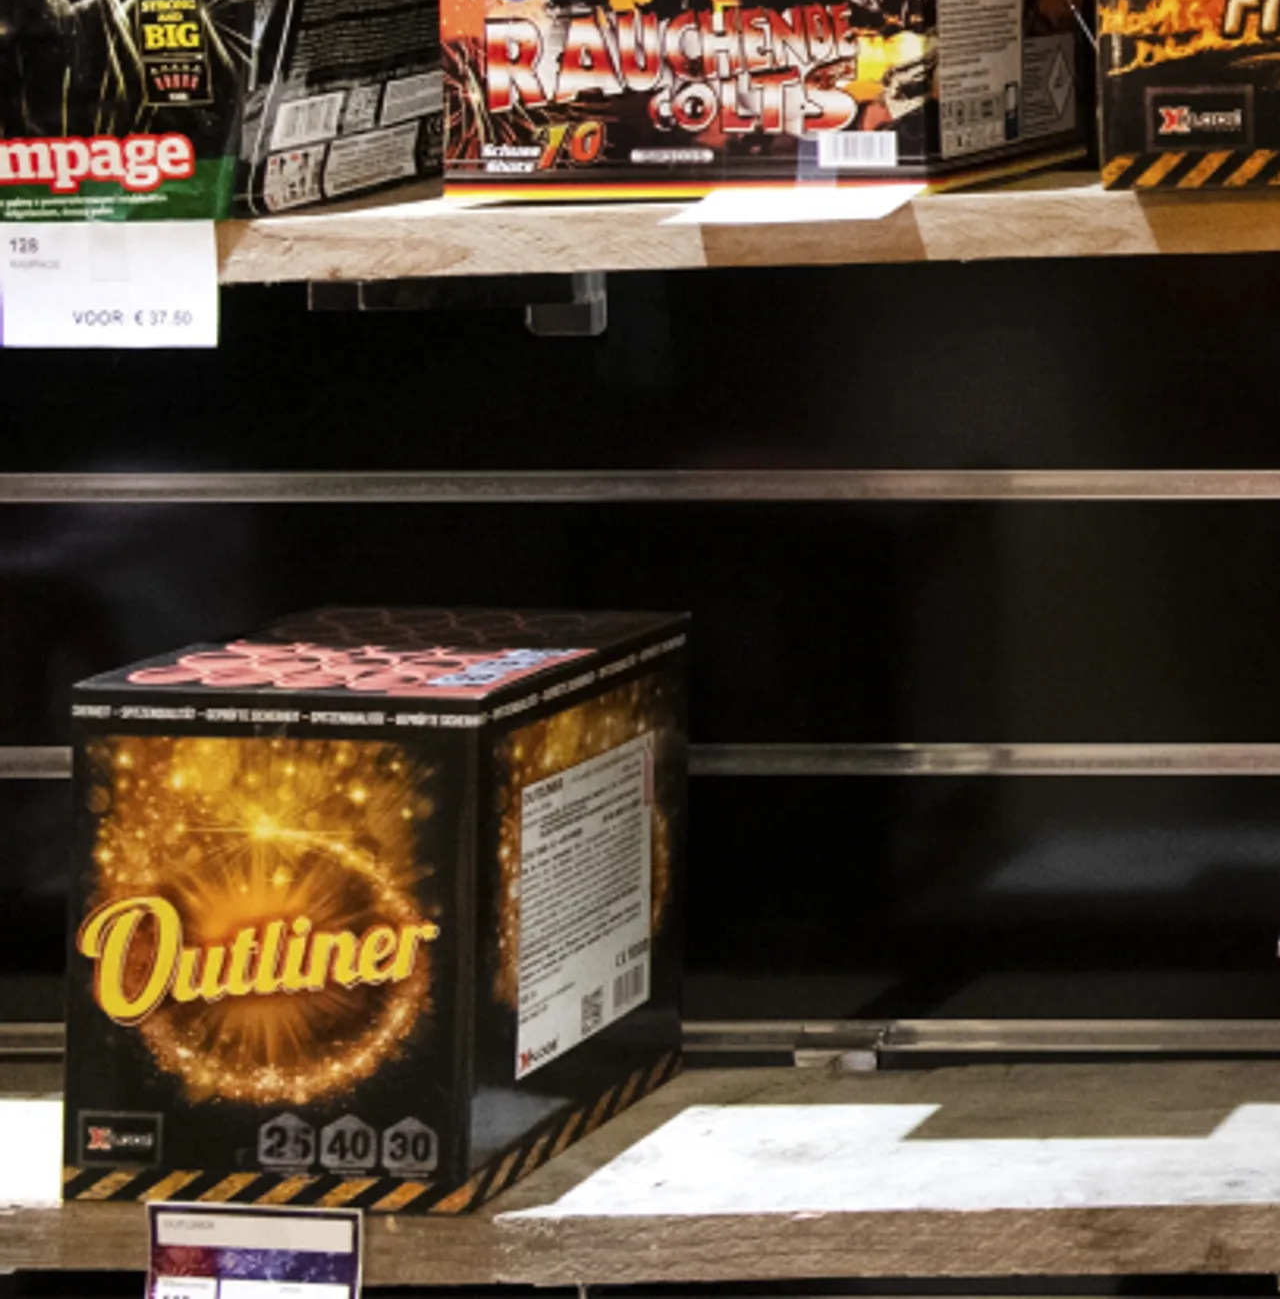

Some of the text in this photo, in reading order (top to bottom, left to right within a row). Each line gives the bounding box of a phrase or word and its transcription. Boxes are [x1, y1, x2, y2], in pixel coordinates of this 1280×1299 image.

[144, 22, 200, 49] BIG
[485, 3, 859, 110] RAUCHENDE
[78, 896, 440, 1025] Outliner
[264, 1125, 433, 1162] 25 40 30
